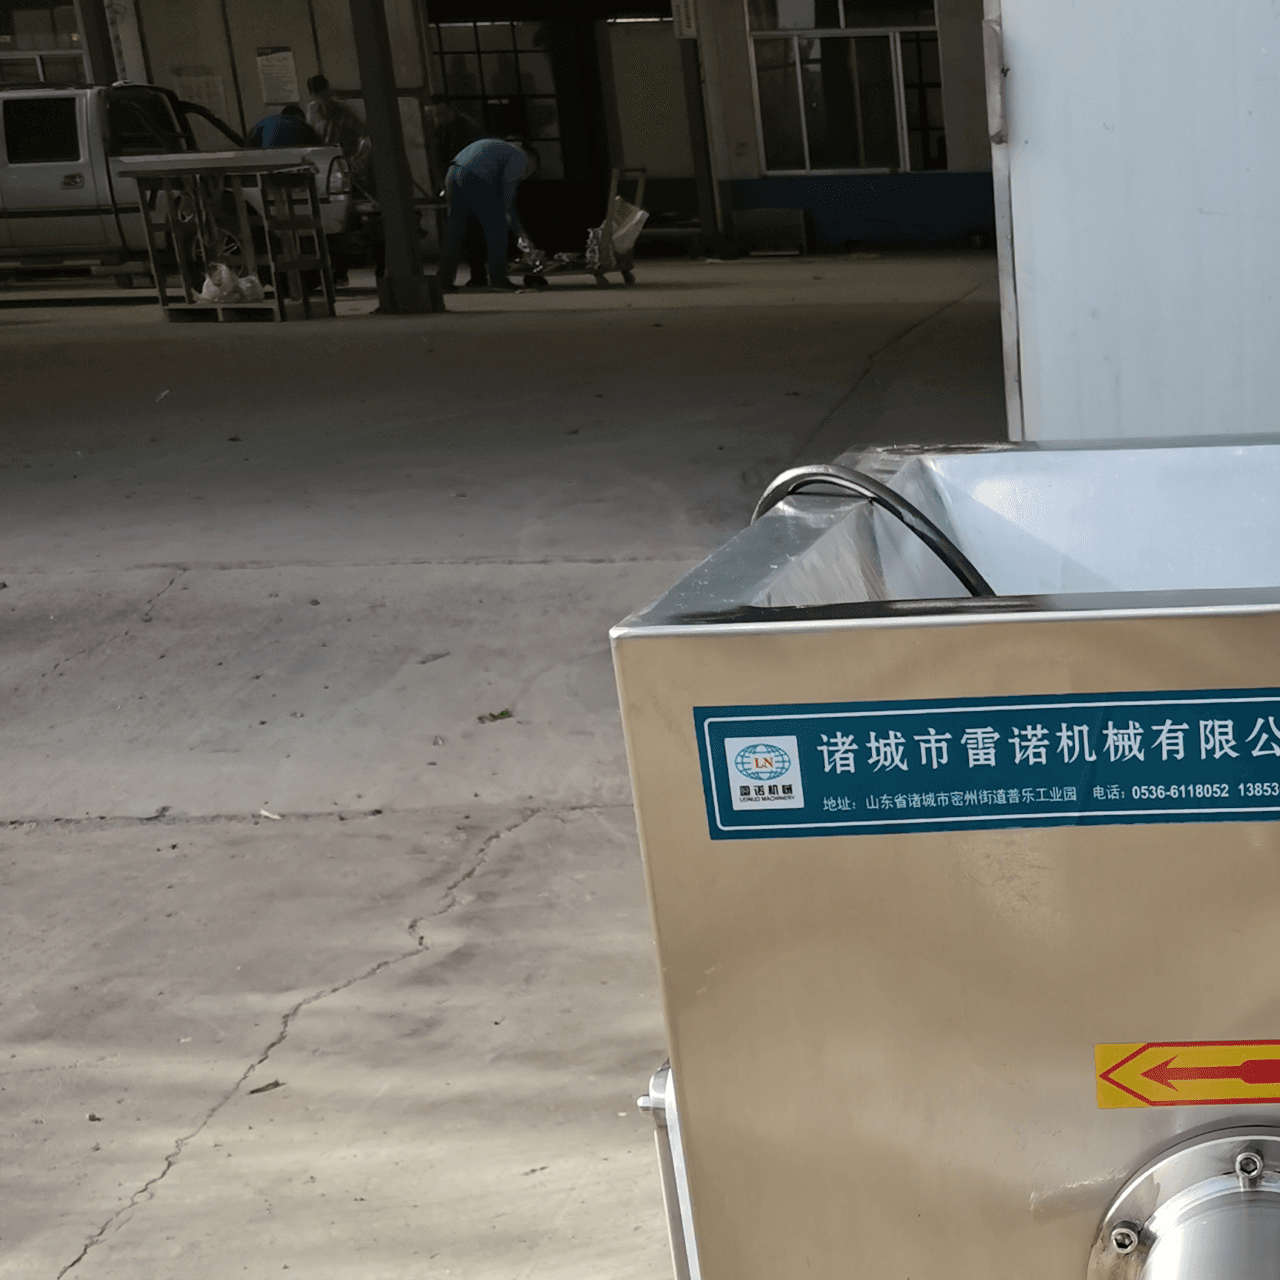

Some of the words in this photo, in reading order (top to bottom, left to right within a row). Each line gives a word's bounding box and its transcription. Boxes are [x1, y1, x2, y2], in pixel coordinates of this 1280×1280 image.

[753, 757, 773, 768] LN
[739, 784, 793, 796] 雷诺机械
